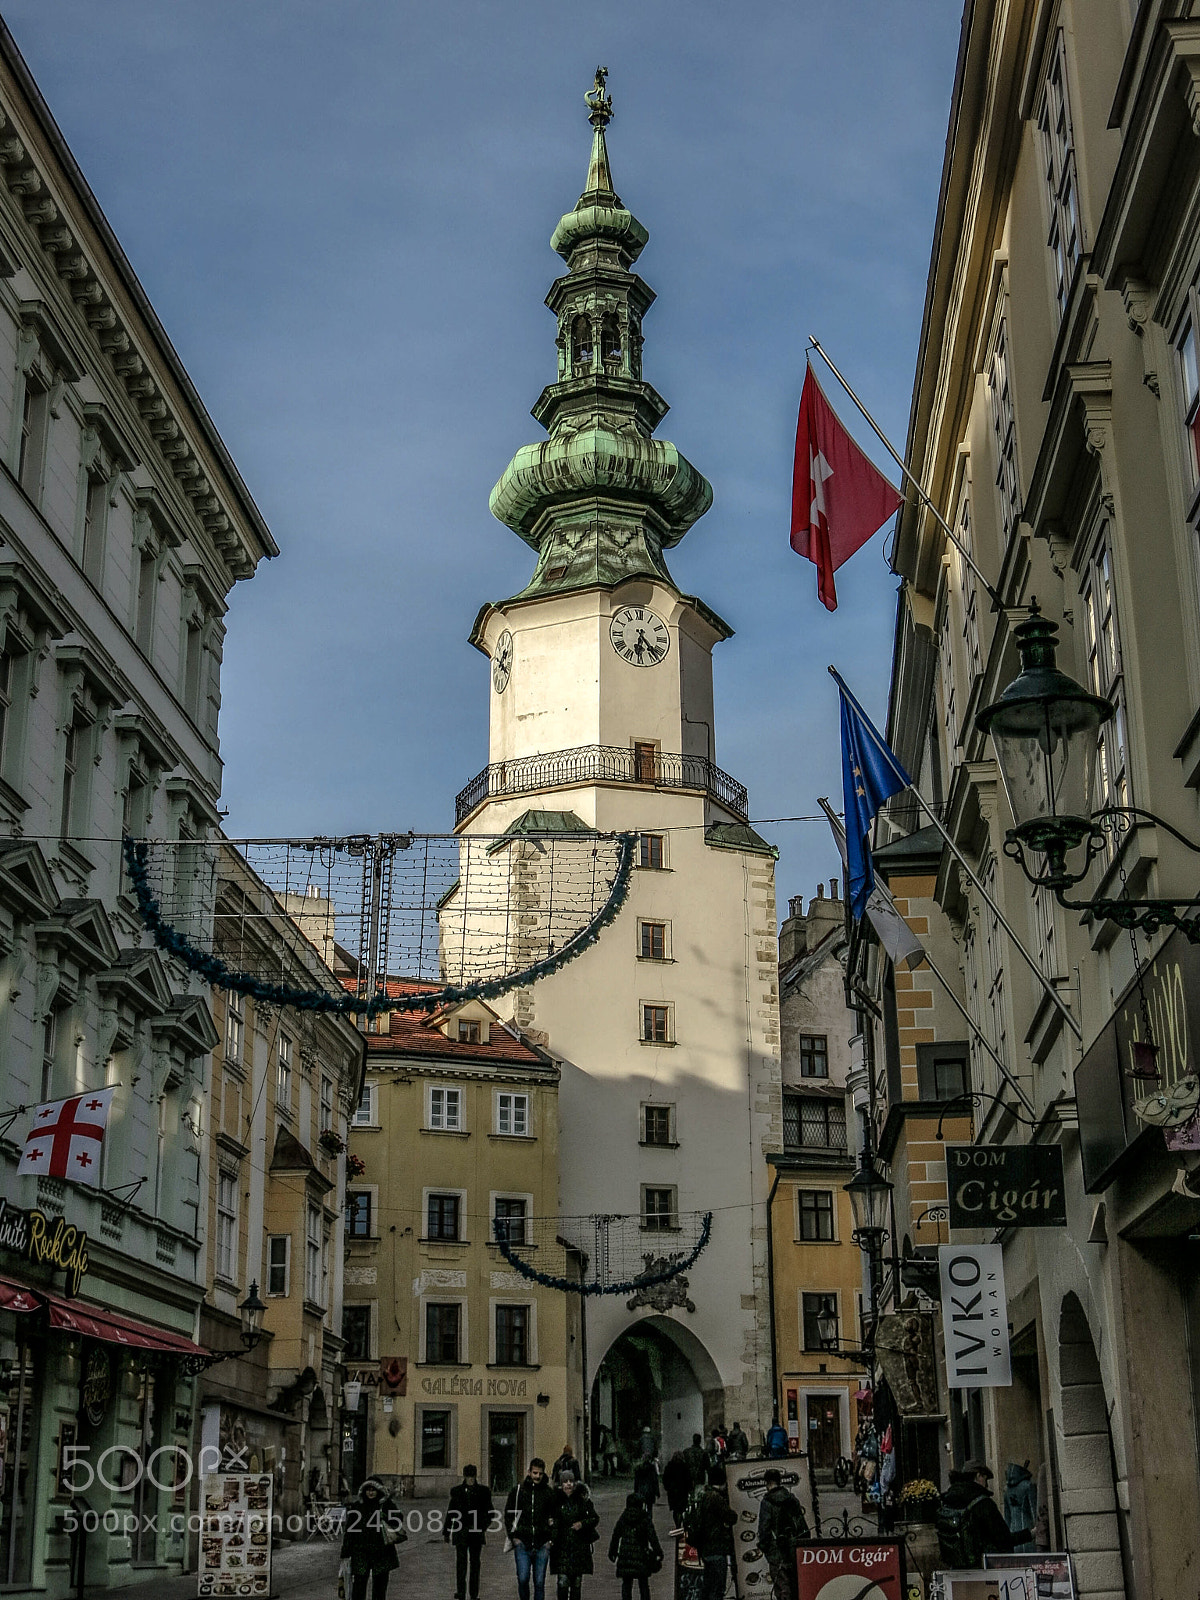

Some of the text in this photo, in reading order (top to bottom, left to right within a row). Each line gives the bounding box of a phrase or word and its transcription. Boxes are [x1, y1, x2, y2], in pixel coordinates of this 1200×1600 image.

[954, 1150, 1006, 1167] DOM
[956, 1180, 1058, 1221] Cigár
[948, 1255, 988, 1377] IVKO
[986, 1272, 1002, 1357] WOMAN
[421, 1374, 527, 1397] GALÉRIA NOVA
[801, 1547, 890, 1567] DOM Cigár
